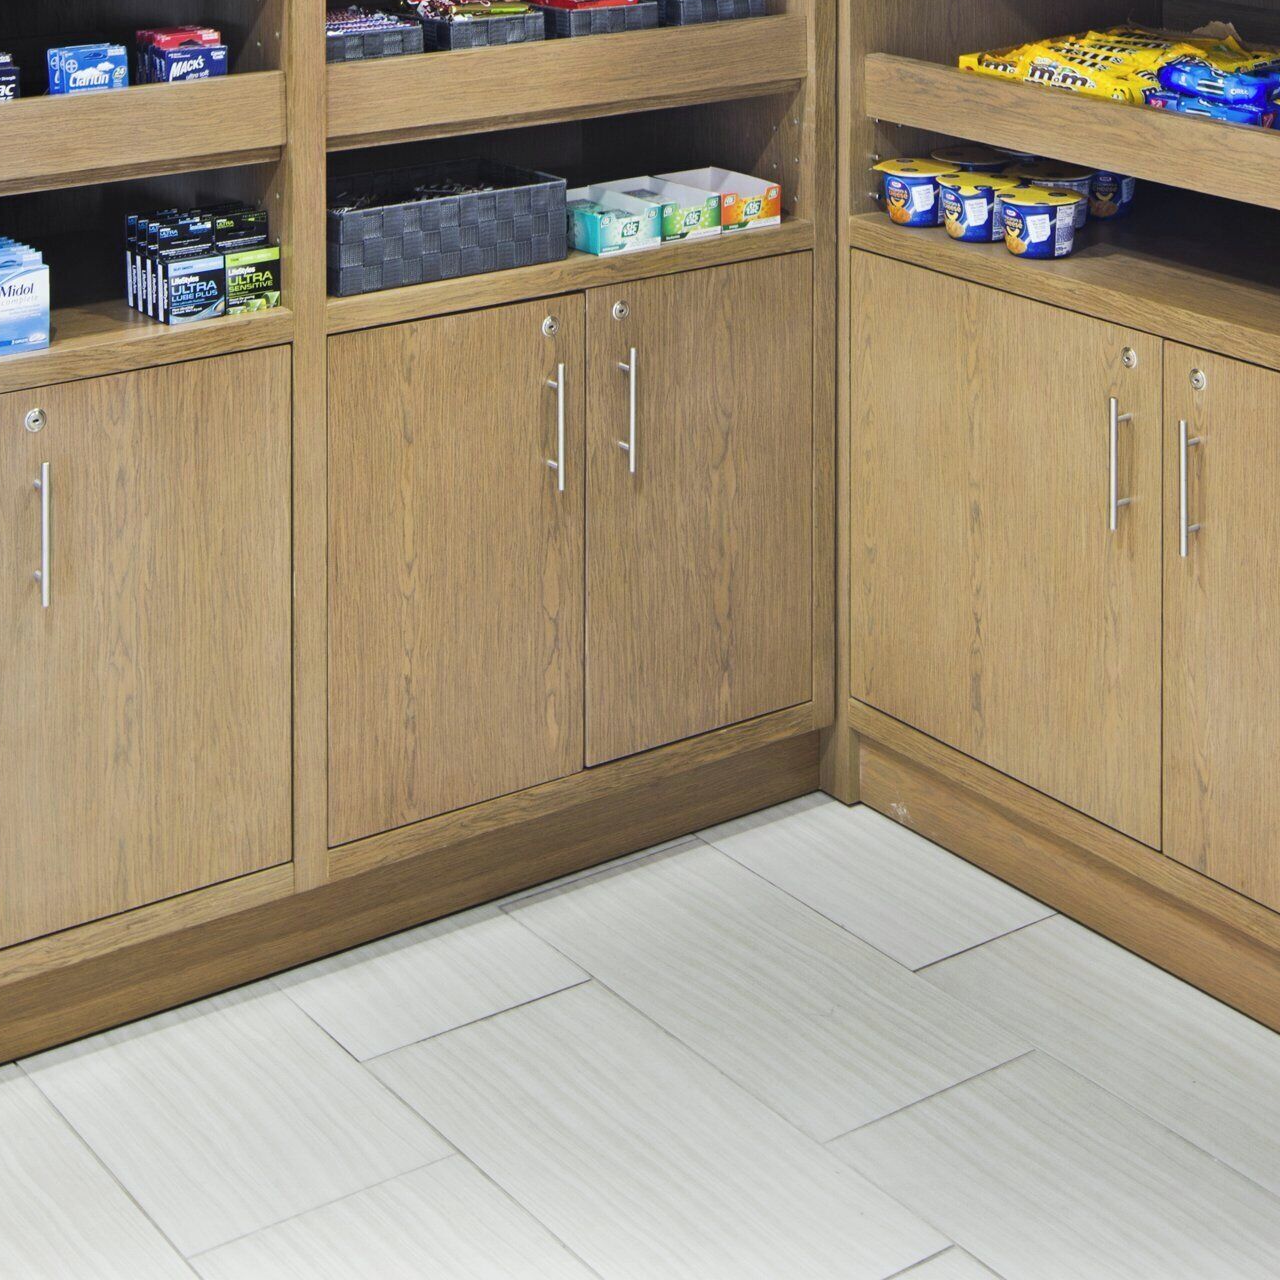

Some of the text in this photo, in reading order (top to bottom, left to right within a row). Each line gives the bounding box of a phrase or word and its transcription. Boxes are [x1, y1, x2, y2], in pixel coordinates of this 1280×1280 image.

[68, 70, 110, 88] Claritin
[228, 270, 273, 286] ULTRA
[171, 280, 218, 295] ULTRA
[228, 280, 273, 292] SENSITIVE
[171, 289, 218, 302] LUBE PLUS
